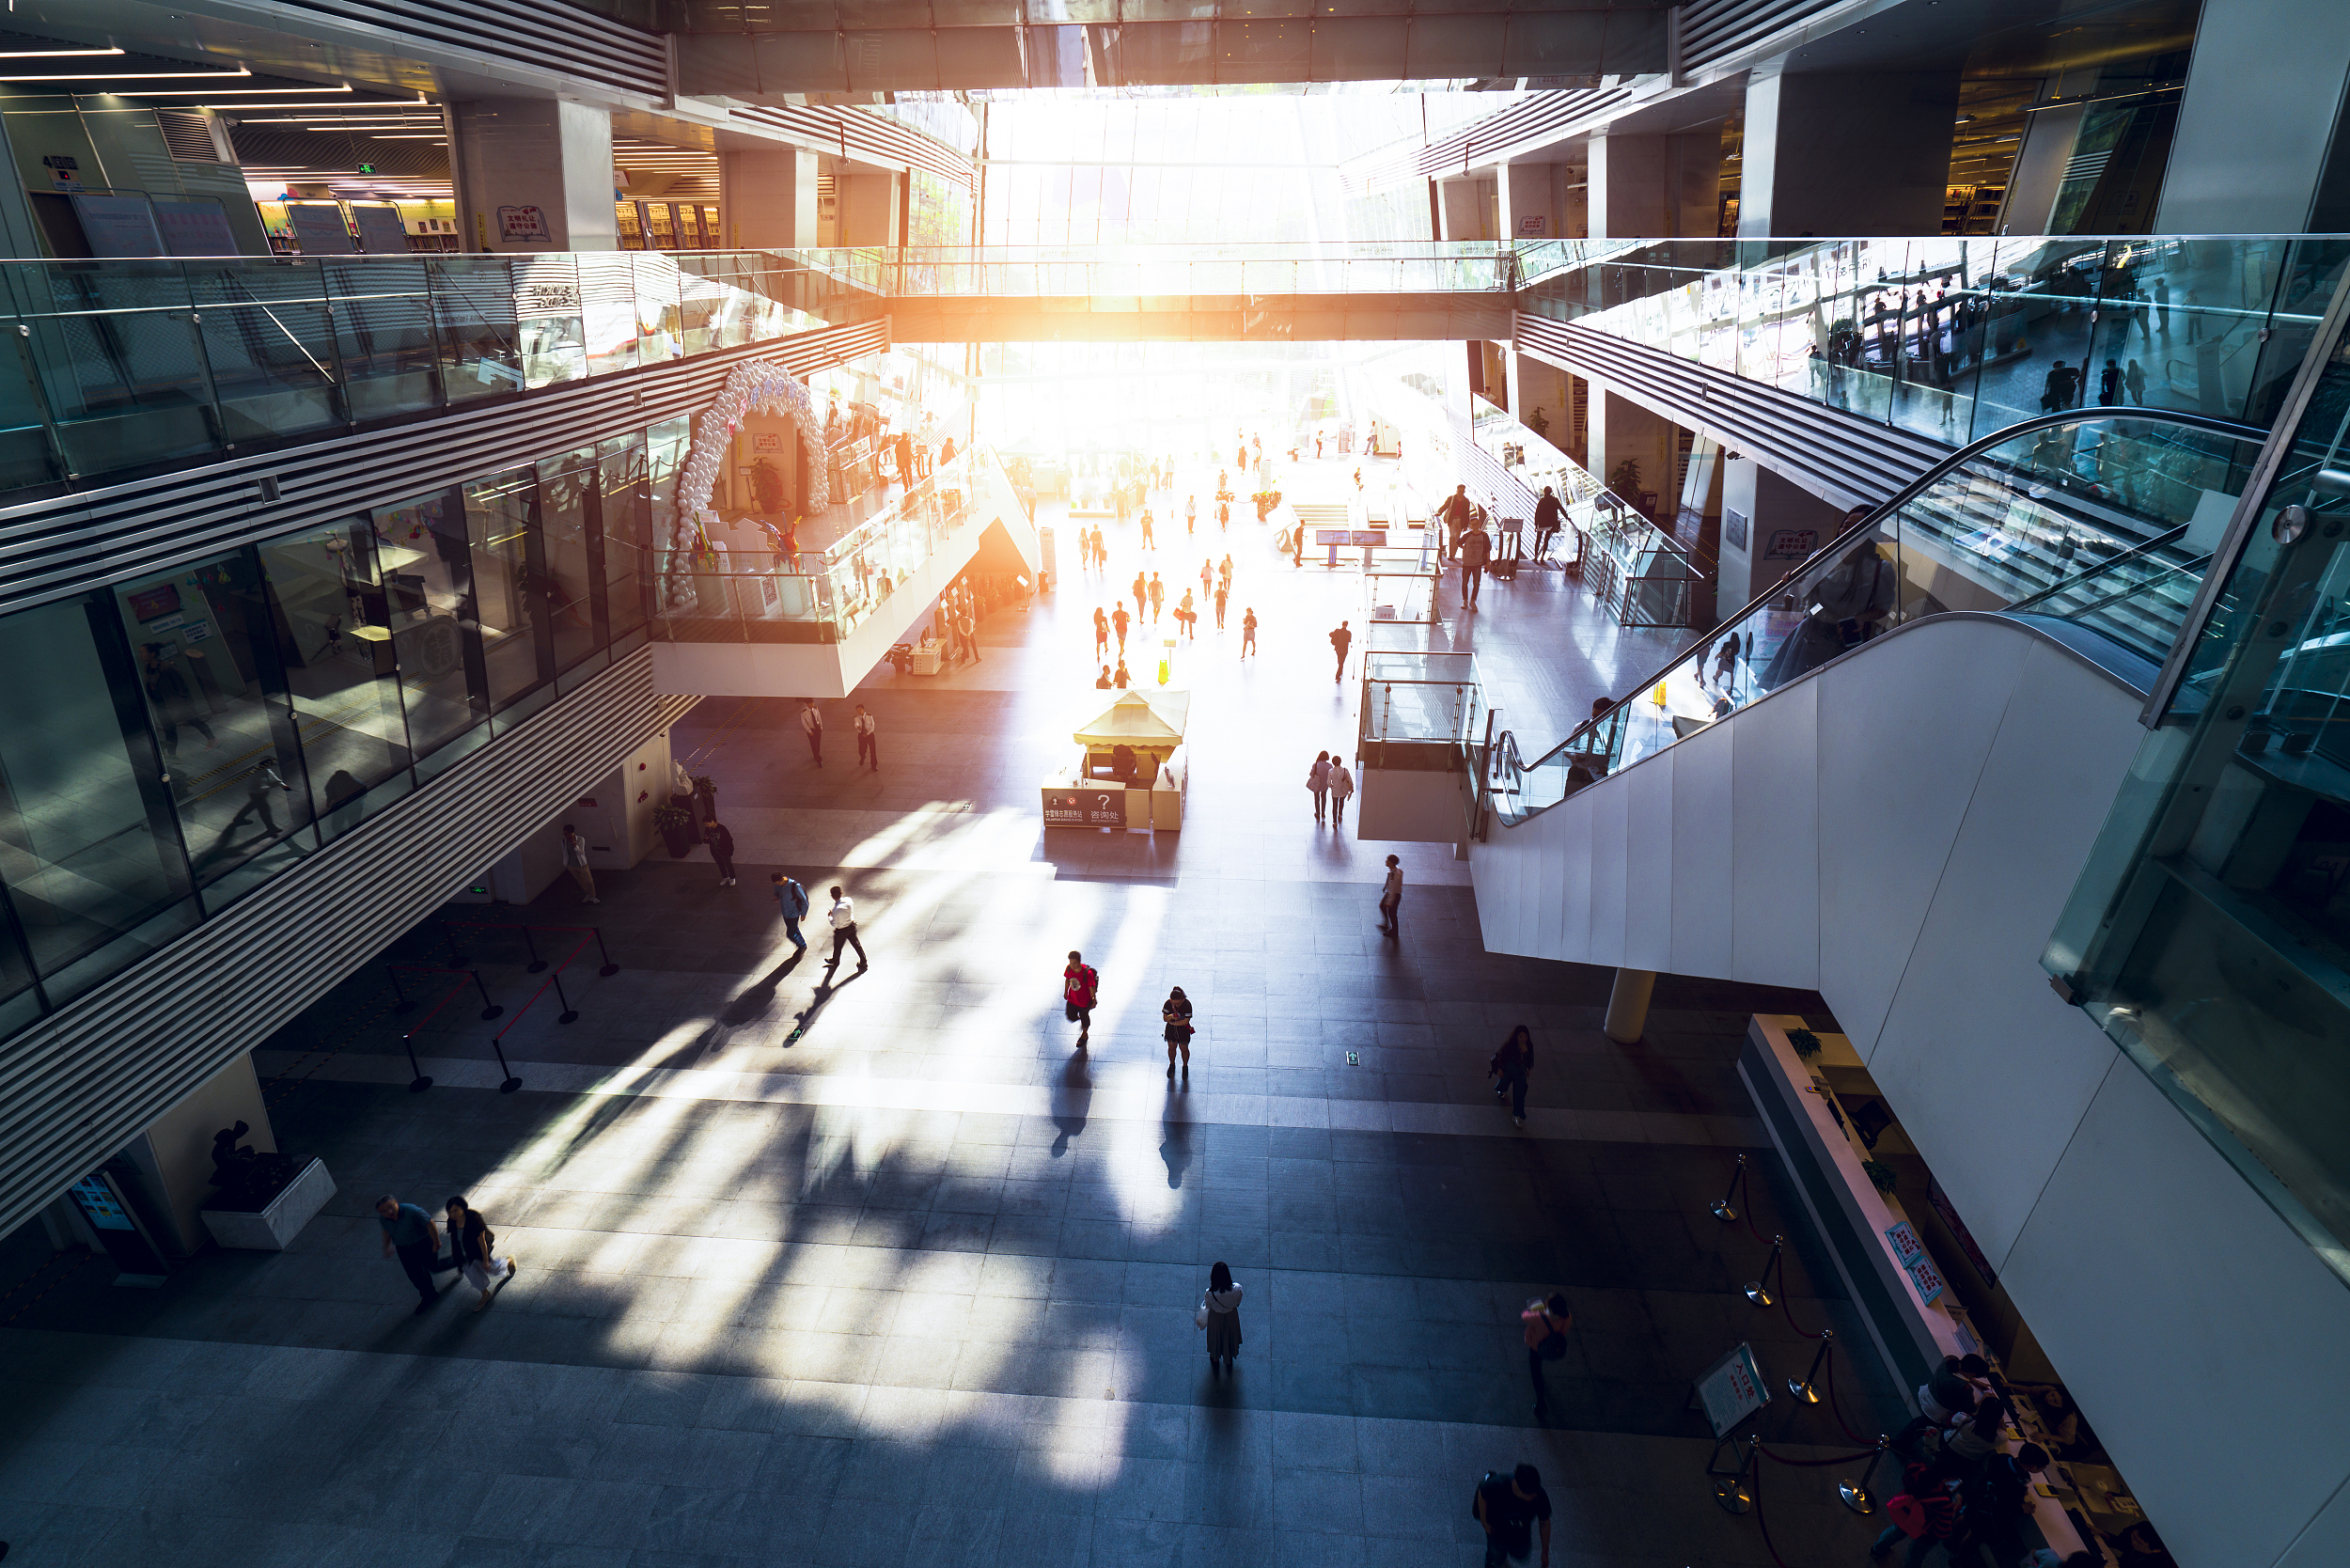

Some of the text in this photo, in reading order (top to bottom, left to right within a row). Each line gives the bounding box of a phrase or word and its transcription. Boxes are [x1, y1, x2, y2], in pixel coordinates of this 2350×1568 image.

[1090, 811, 1120, 820] 咨询处
[1735, 1363, 1756, 1399] 入口处
